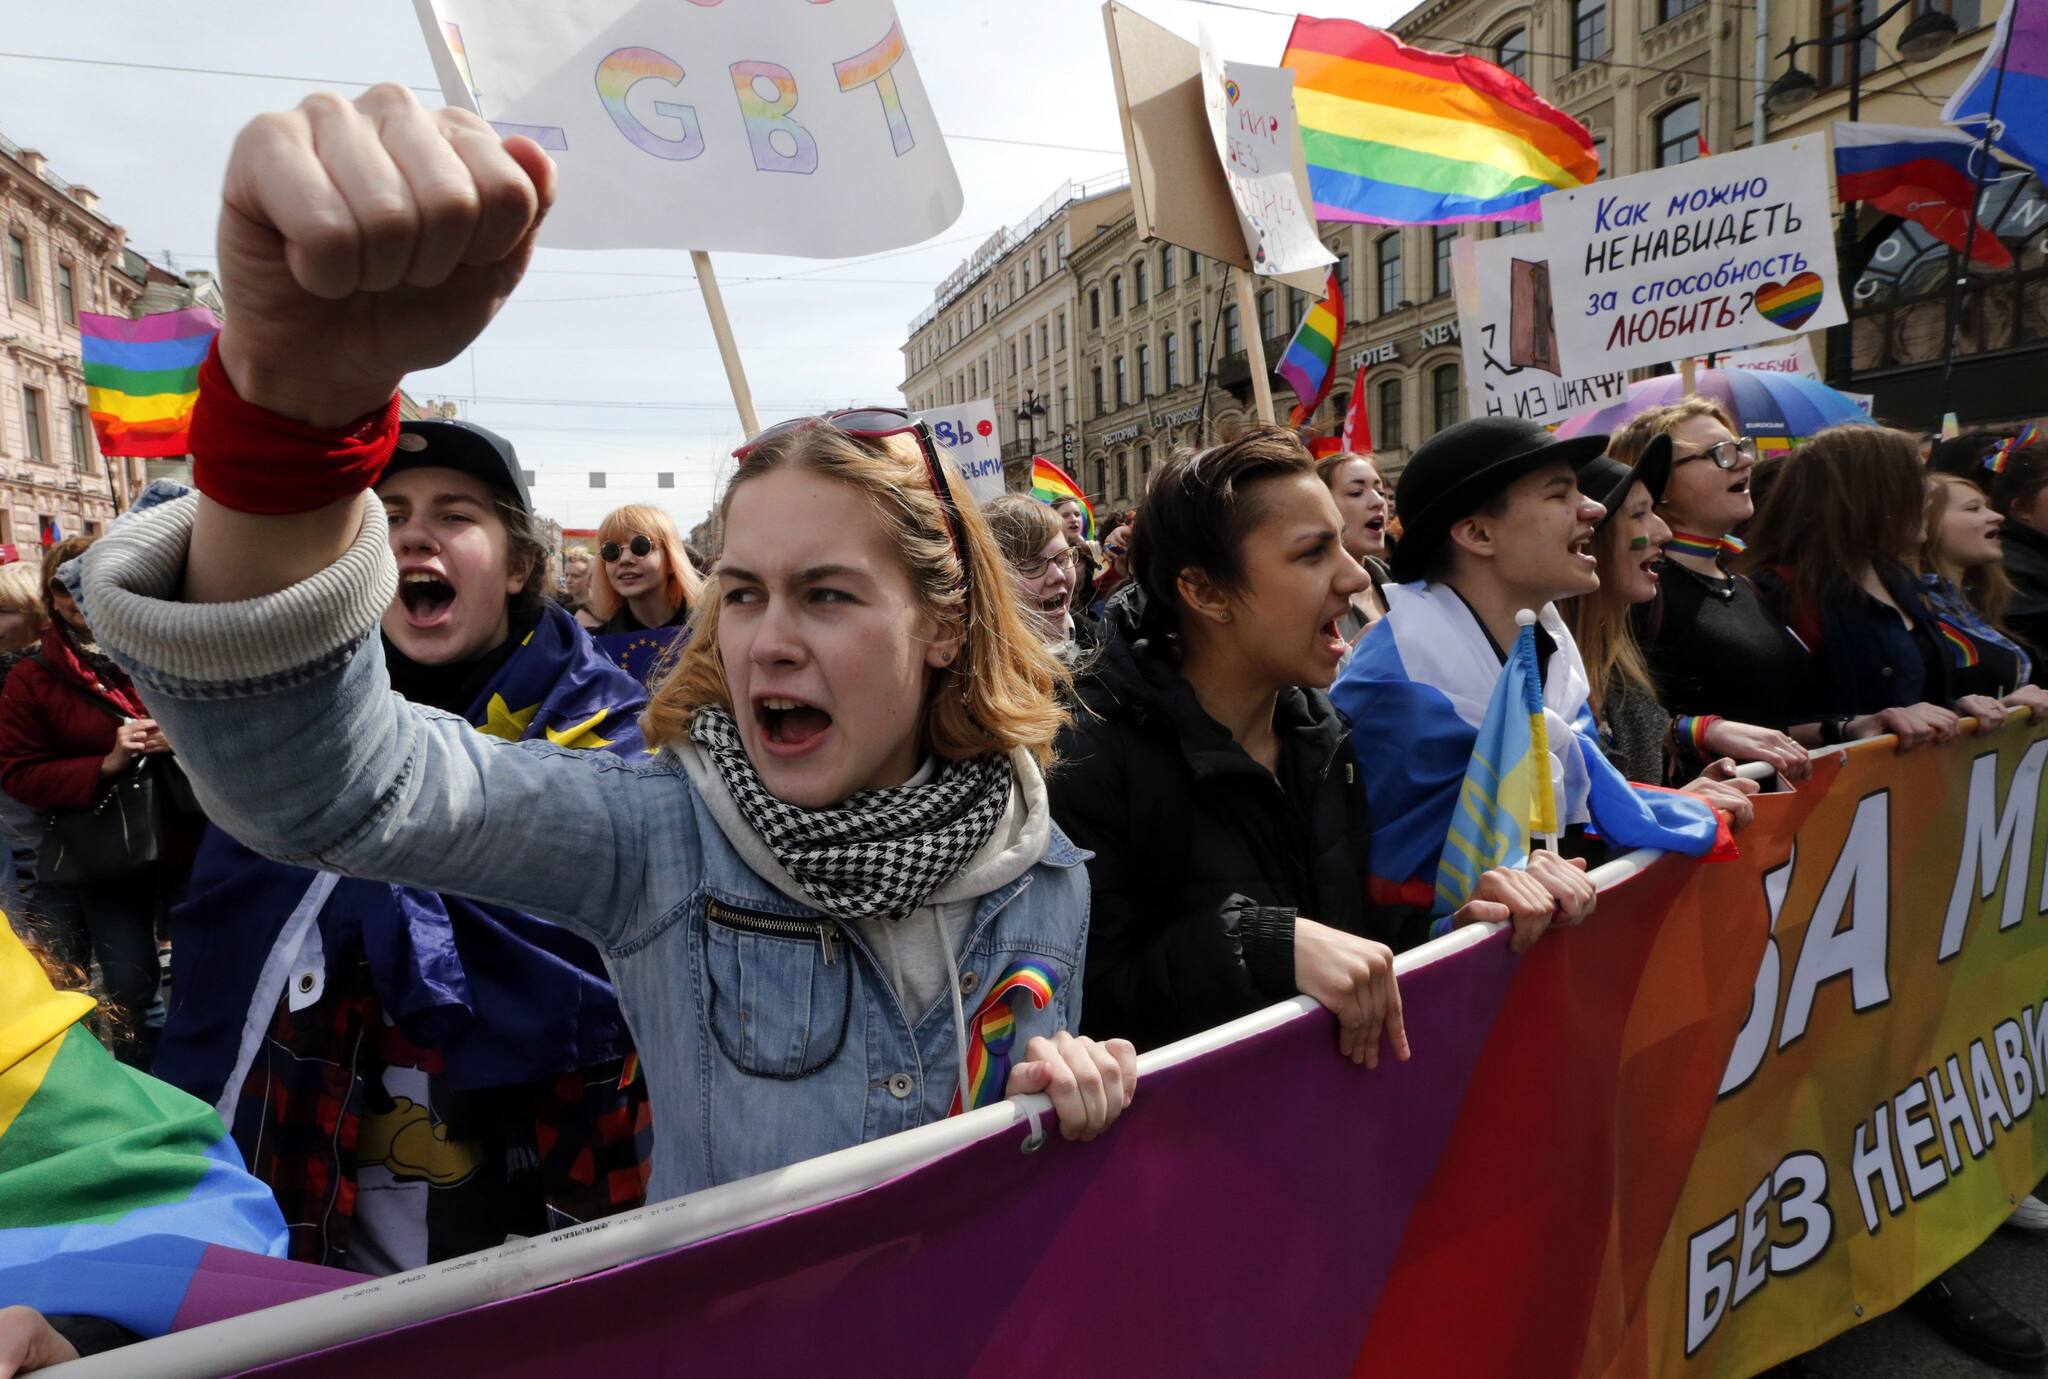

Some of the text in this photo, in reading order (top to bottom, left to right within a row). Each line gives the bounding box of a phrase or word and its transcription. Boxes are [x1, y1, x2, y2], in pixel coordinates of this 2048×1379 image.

[1594, 176, 1768, 234] Как можно
[1583, 202, 1803, 276] НЕНАВИДЕТЬ
[1585, 249, 1809, 317] за способность
[1605, 291, 1755, 352] ЛЮБИТЬ?
[1350, 341, 1400, 371] HOTEL
[1514, 386, 1548, 419] ИЗ
[1102, 425, 1139, 446] РЕСТОРАН
[1936, 735, 2048, 964] М
[1685, 998, 2048, 1359] БЕЗ НЕНАВИ
